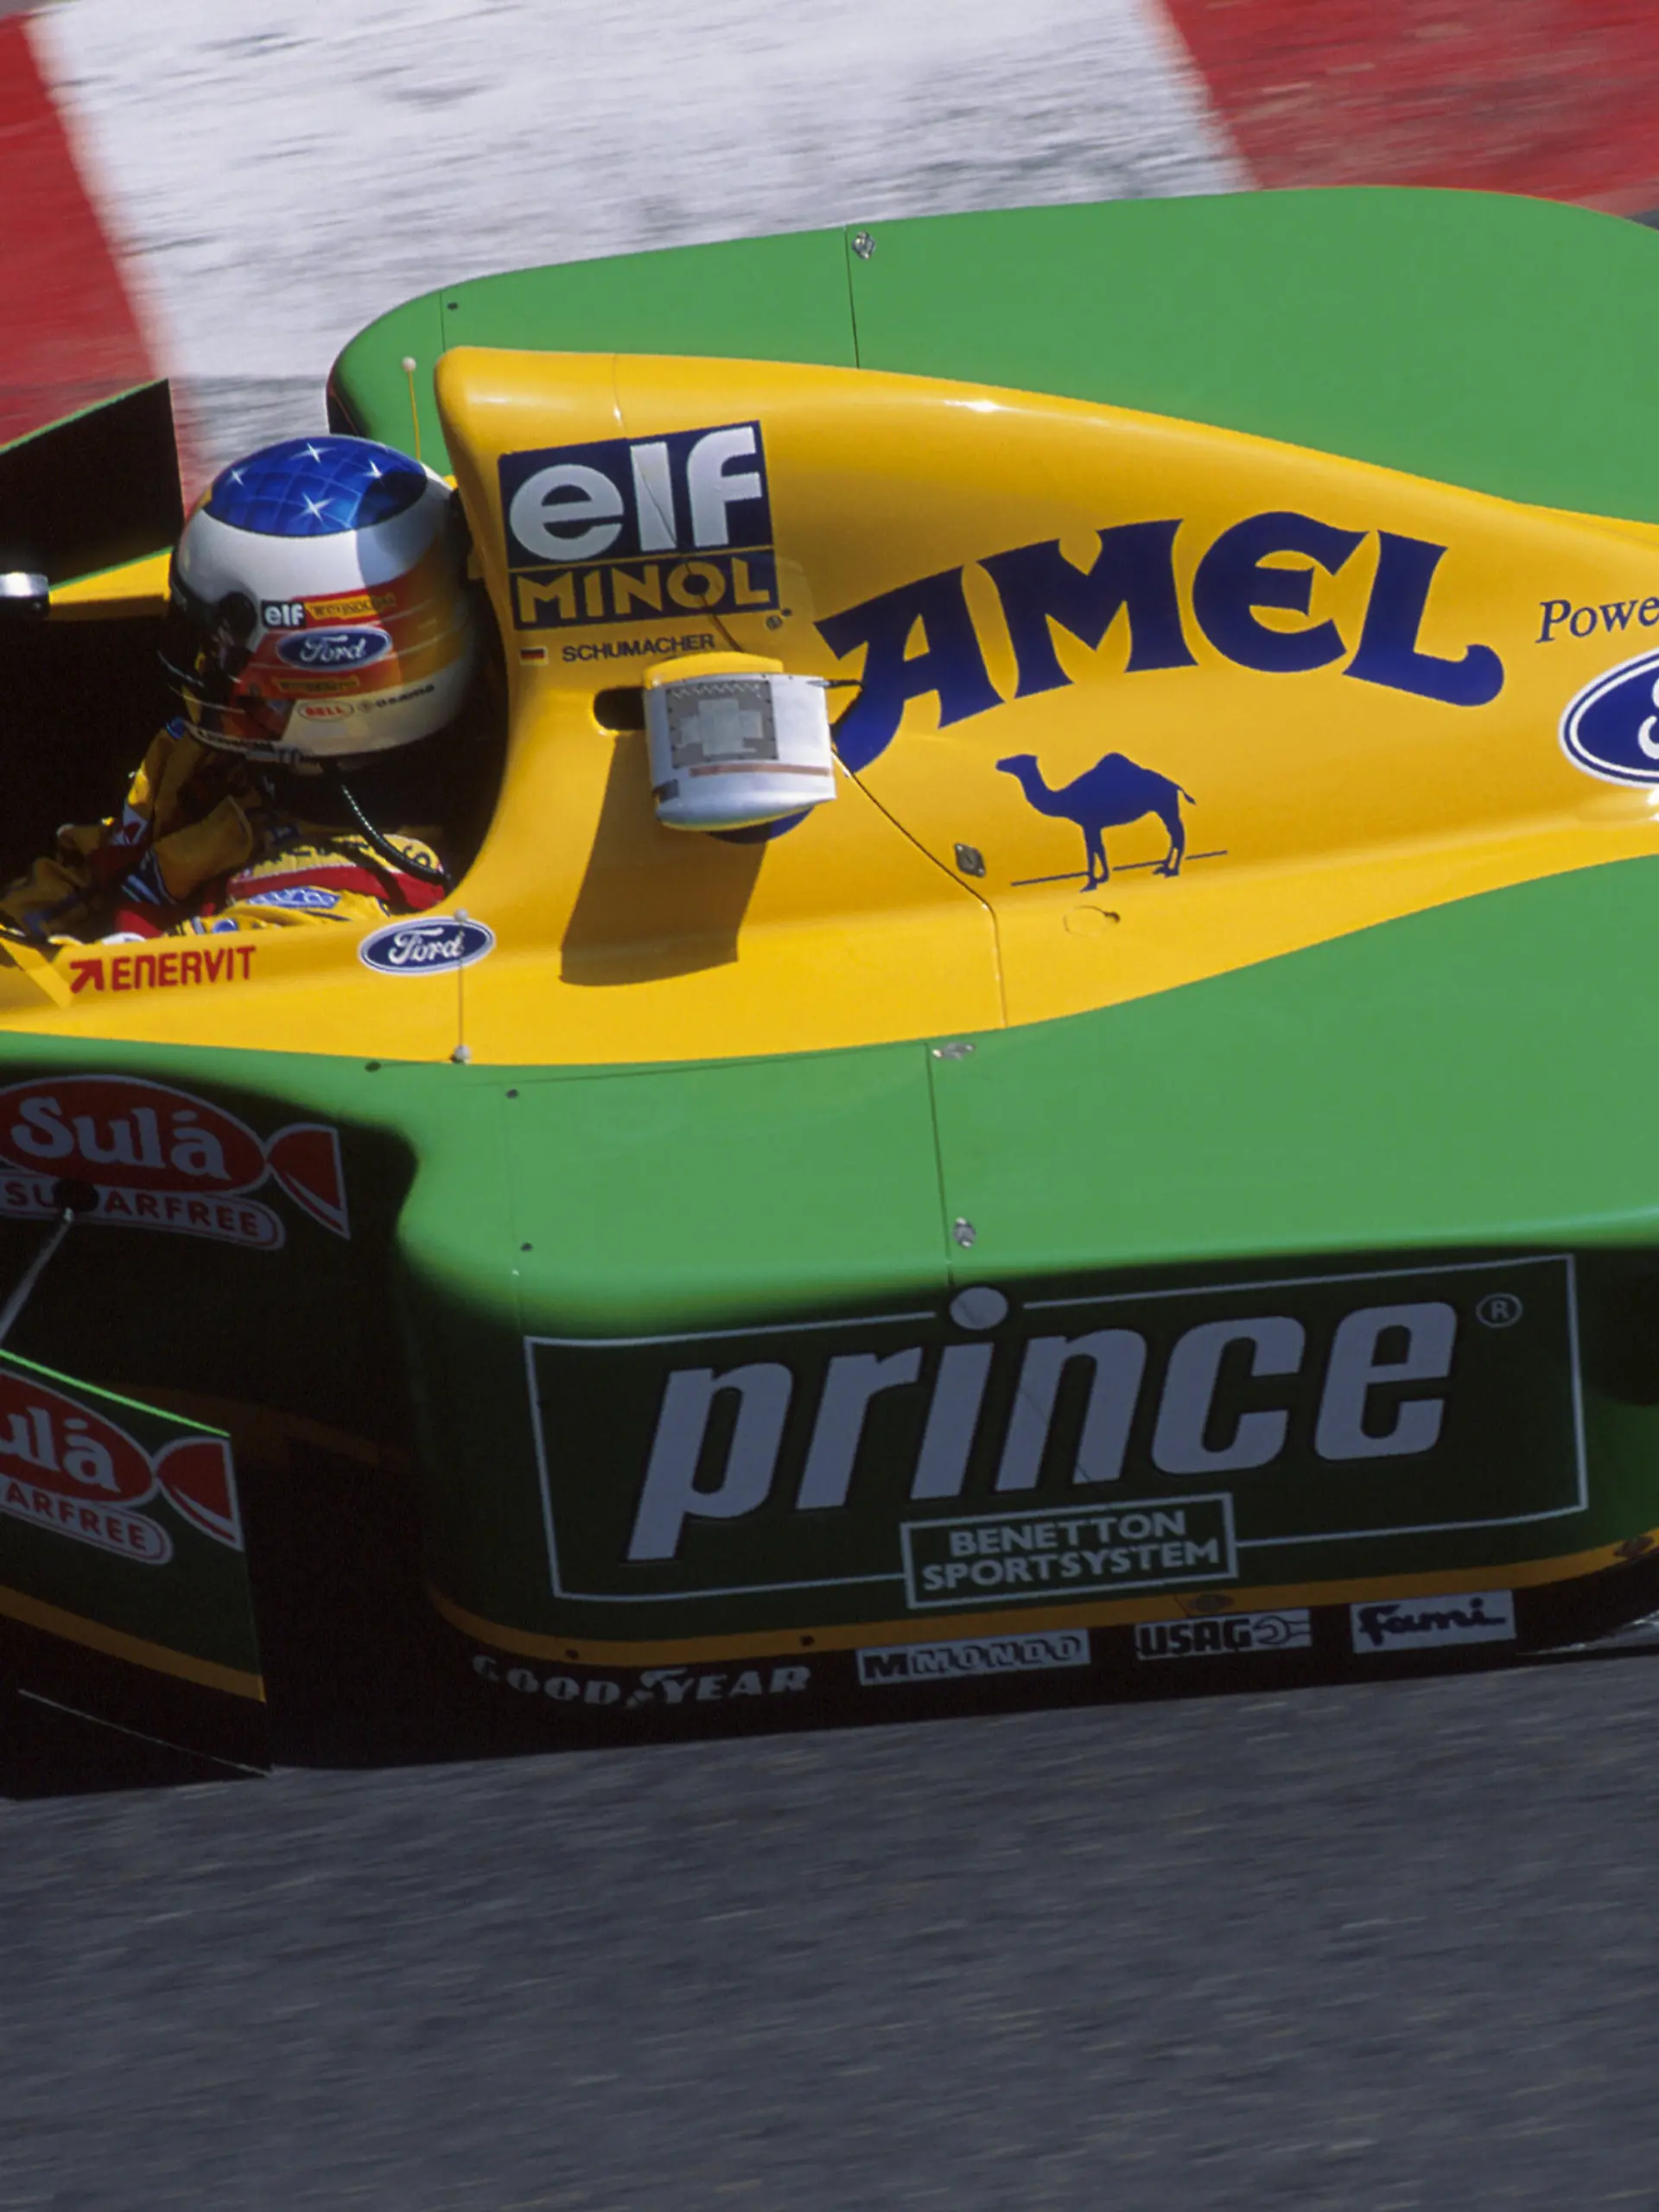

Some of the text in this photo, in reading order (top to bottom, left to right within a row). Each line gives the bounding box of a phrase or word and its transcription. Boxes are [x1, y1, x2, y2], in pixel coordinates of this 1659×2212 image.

[510, 426, 762, 562] elf
[516, 557, 771, 624] MINOL
[264, 603, 305, 626] elf
[299, 634, 366, 663] Ford
[562, 633, 715, 663] SCHUMACHER
[704, 511, 1504, 845] AMEL
[111, 945, 257, 992] ENERVIT
[388, 928, 464, 966] Ford
[4, 1180, 261, 1237] SUARFREE
[627, 1286, 1458, 1560] prince
[950, 1510, 1186, 1556] BENETTON
[921, 1538, 1219, 1592] SPORTSYSTEM
[1137, 1618, 1252, 1656] USAG
